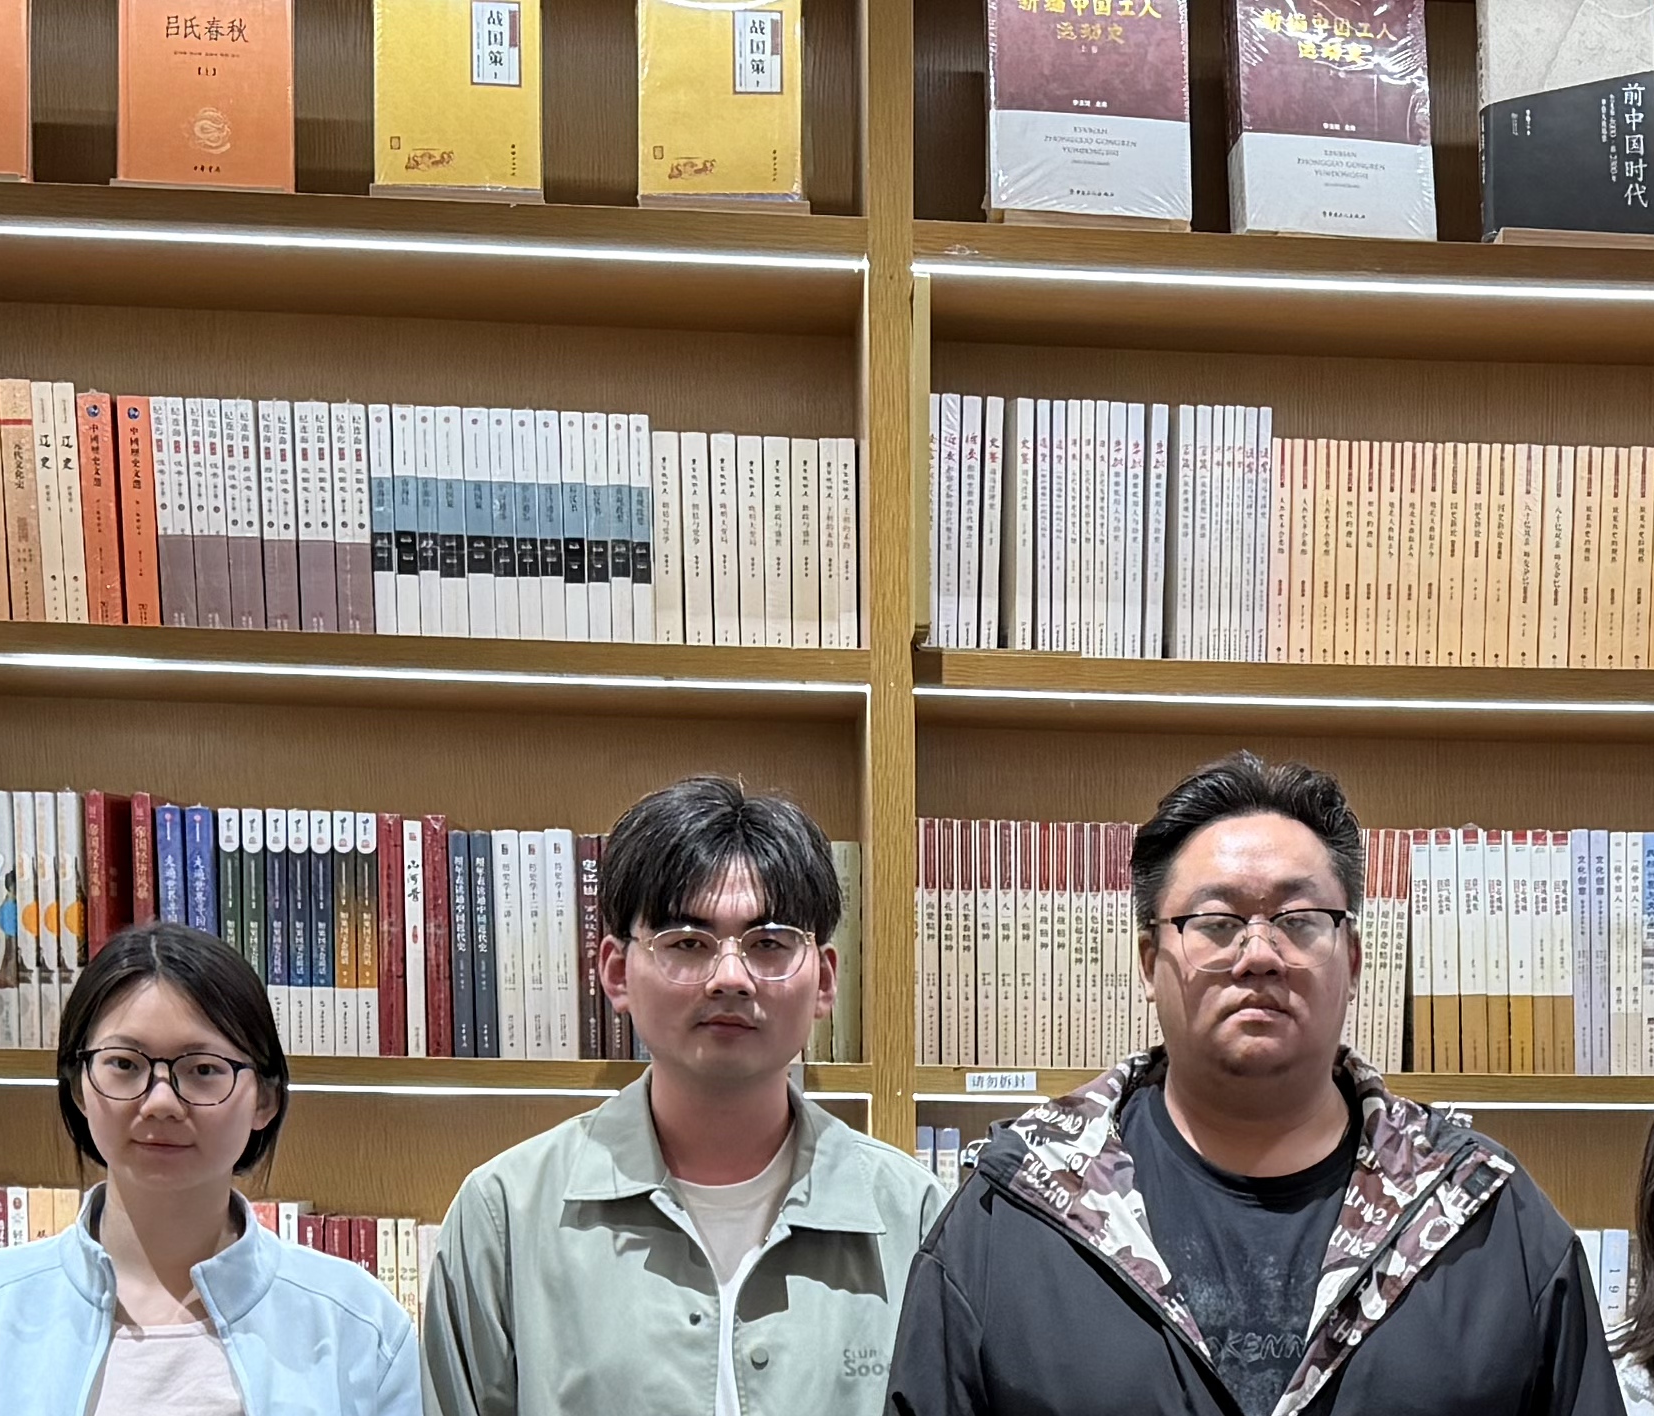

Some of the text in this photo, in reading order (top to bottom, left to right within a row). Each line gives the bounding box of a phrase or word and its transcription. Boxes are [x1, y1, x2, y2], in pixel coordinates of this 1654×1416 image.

[165, 14, 249, 43] 吕氏春秋
[487, 10, 505, 67] 战国策
[749, 19, 766, 75] 战国策
[1621, 83, 1649, 207] 前中国时代
[39, 434, 51, 470] 辽史
[61, 434, 74, 471] 辽史
[972, 1075, 1026, 1089] 请勿拆封
